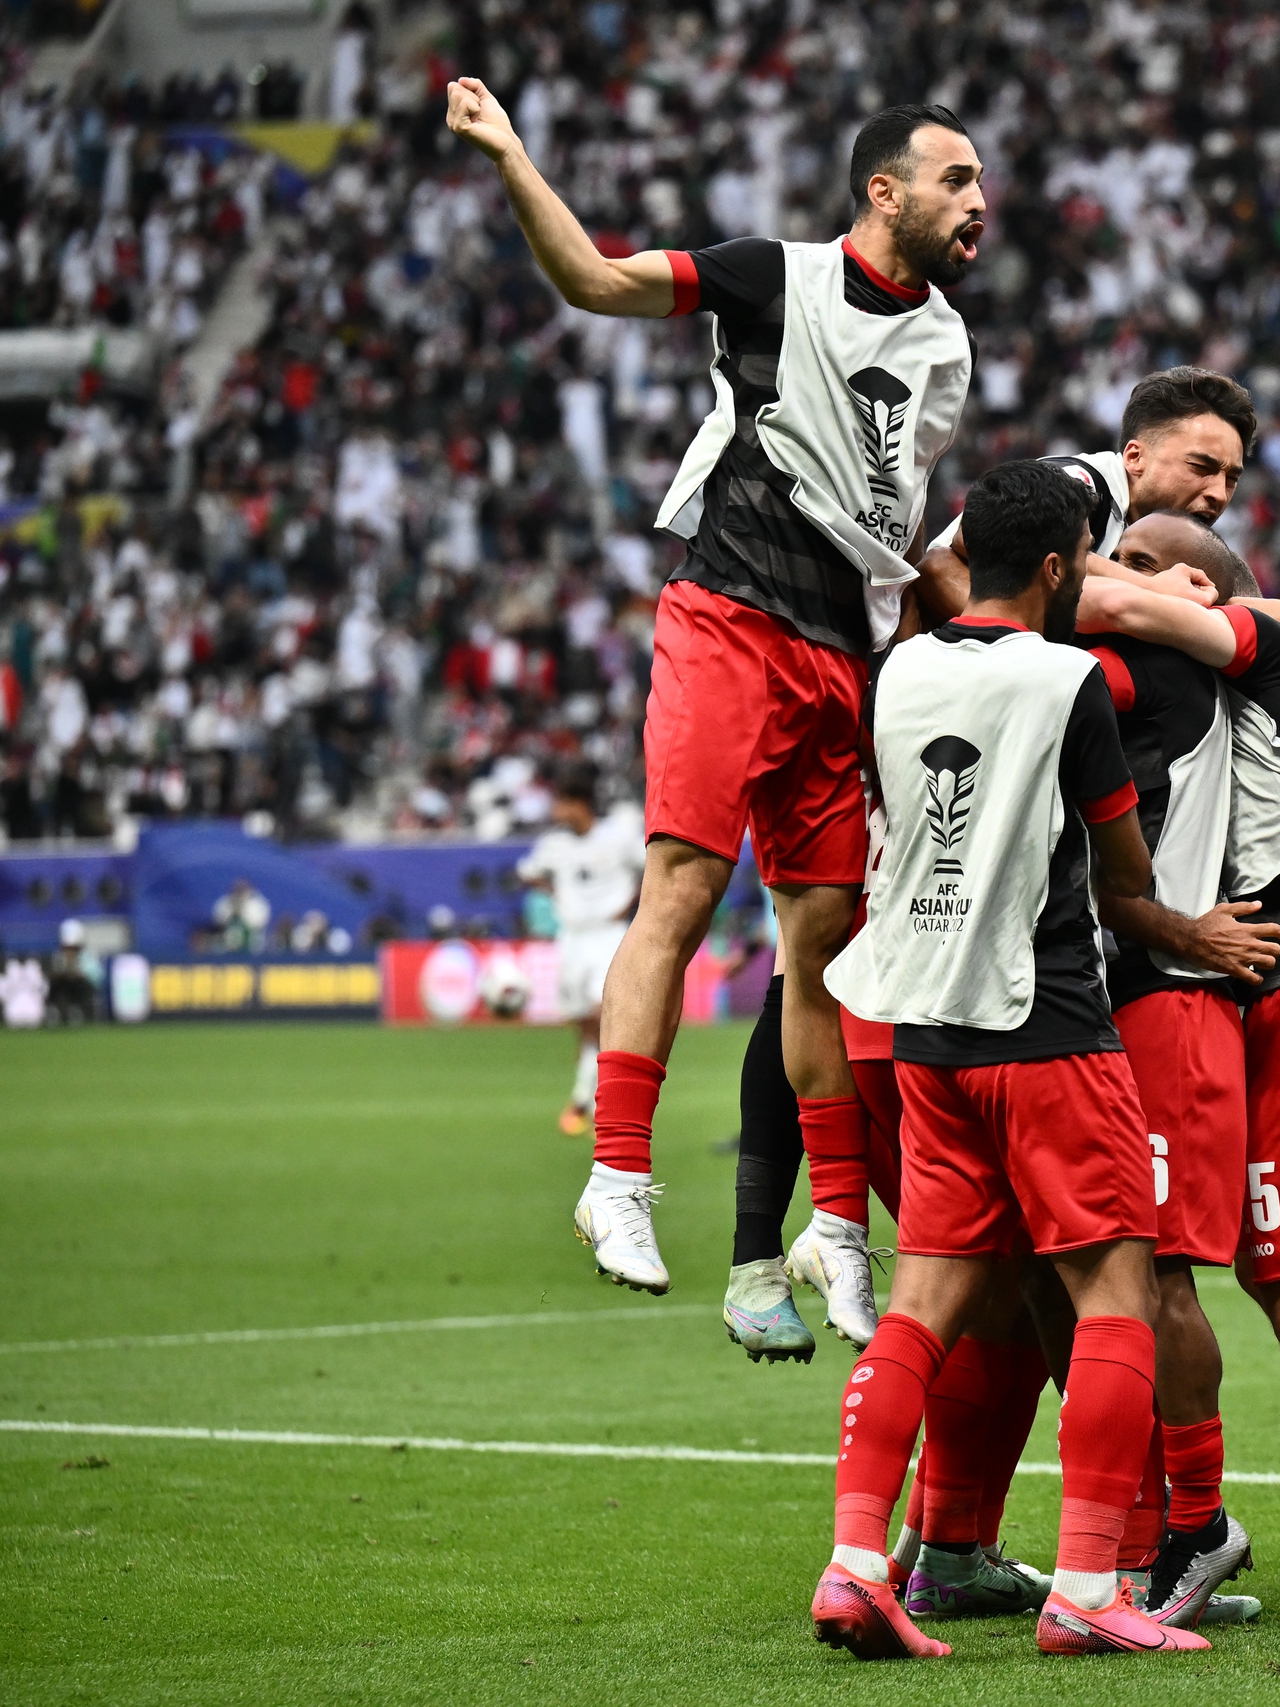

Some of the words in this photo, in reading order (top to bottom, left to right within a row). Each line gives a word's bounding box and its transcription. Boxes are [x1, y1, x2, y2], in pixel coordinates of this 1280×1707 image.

[937, 883, 960, 896] AFC
[909, 897, 954, 916] ASIAN
[913, 917, 950, 936] QATAR
